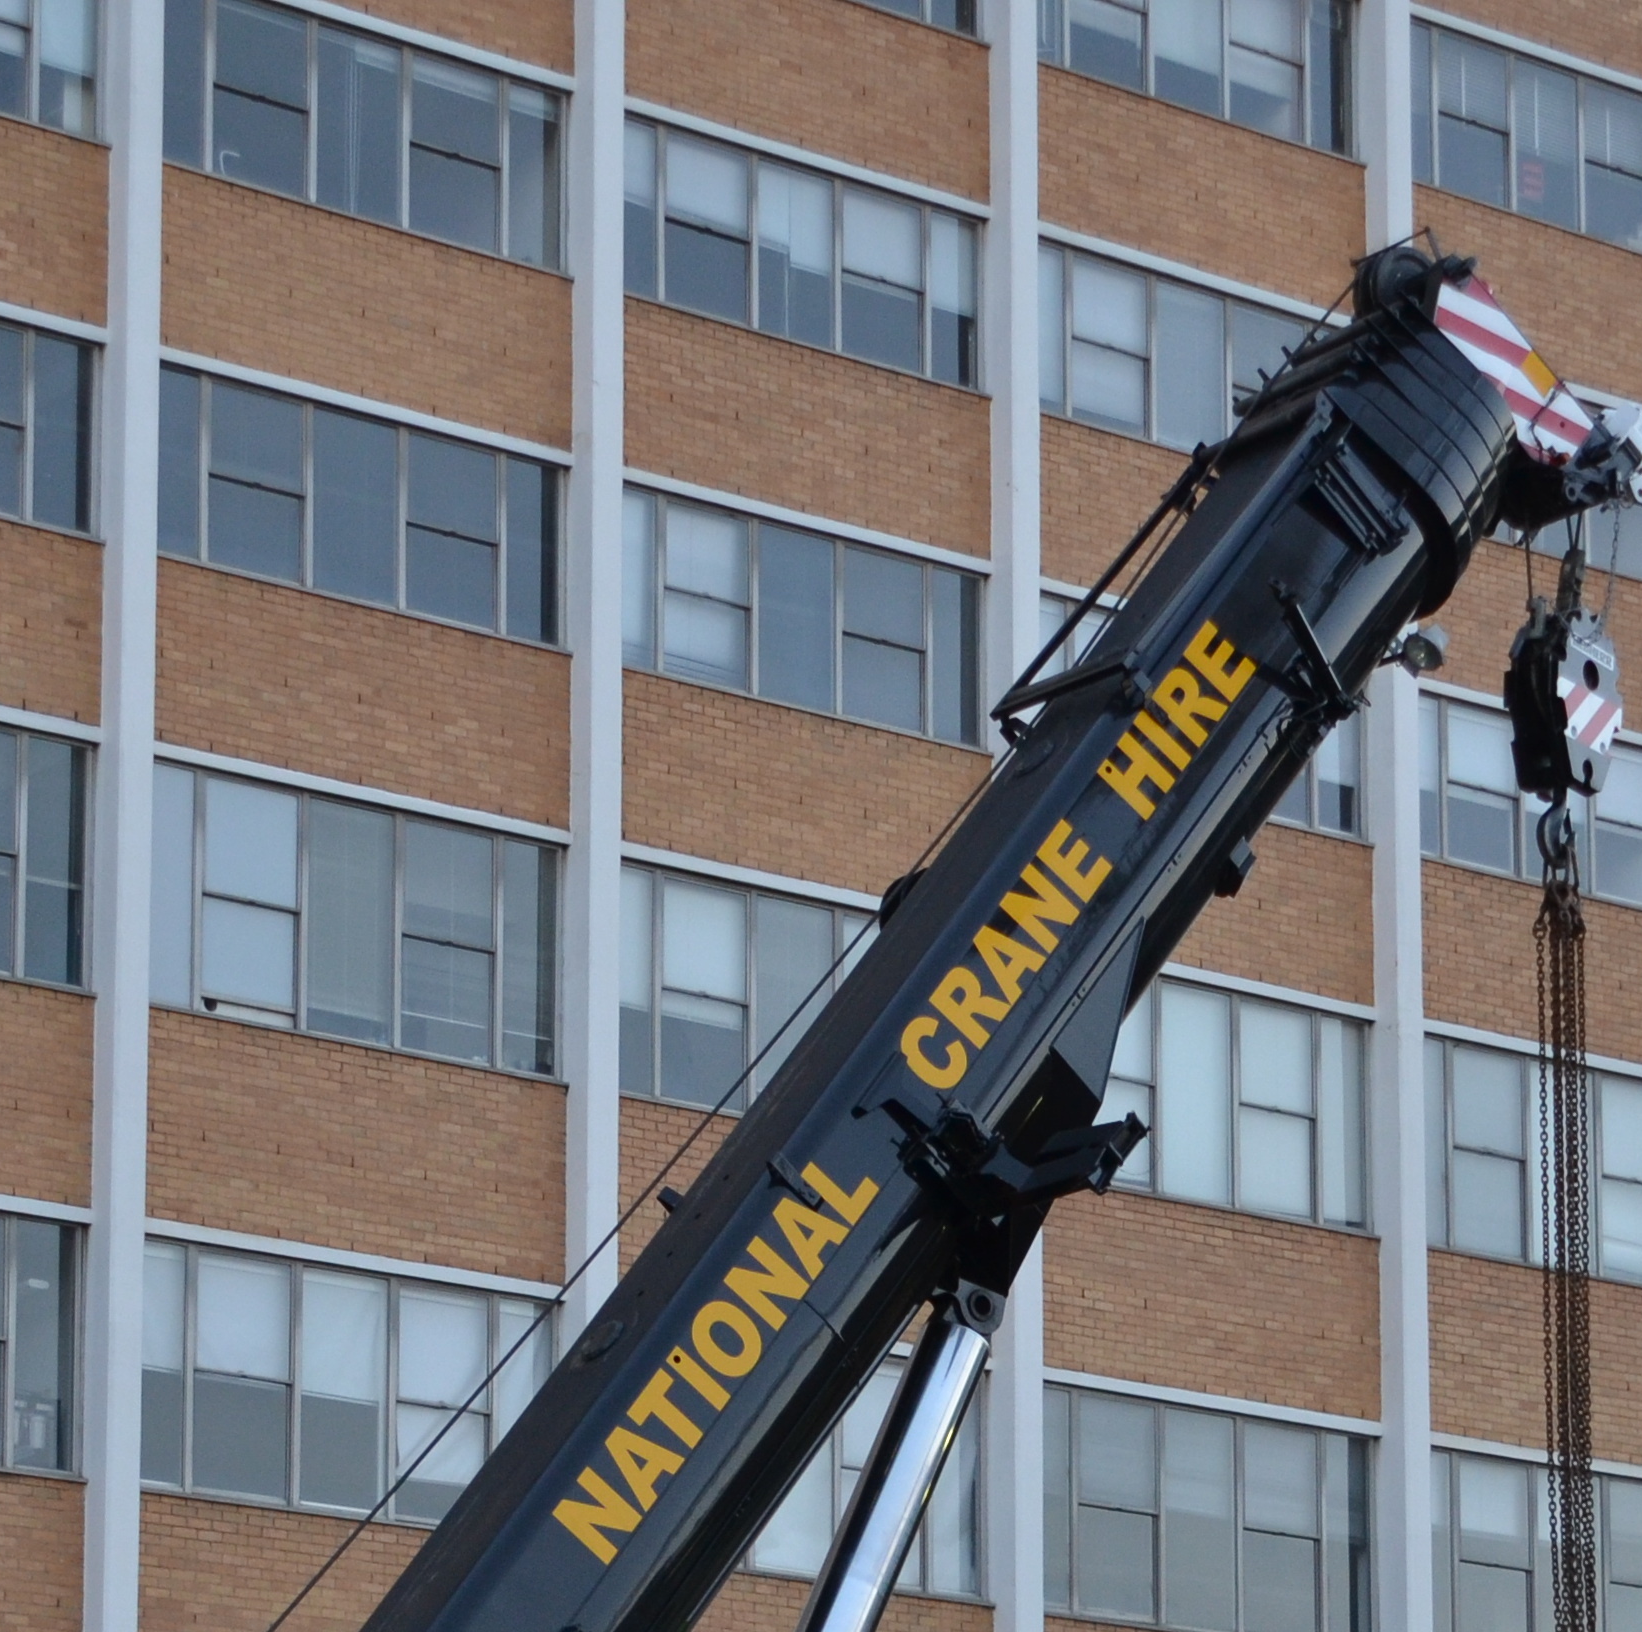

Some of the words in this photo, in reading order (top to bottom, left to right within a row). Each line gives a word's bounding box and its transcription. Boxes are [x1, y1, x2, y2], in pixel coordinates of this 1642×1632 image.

[554, 1163, 879, 1563] NATIONAL
[903, 818, 1113, 1088] CRANE
[1097, 620, 1257, 820] HIRE
